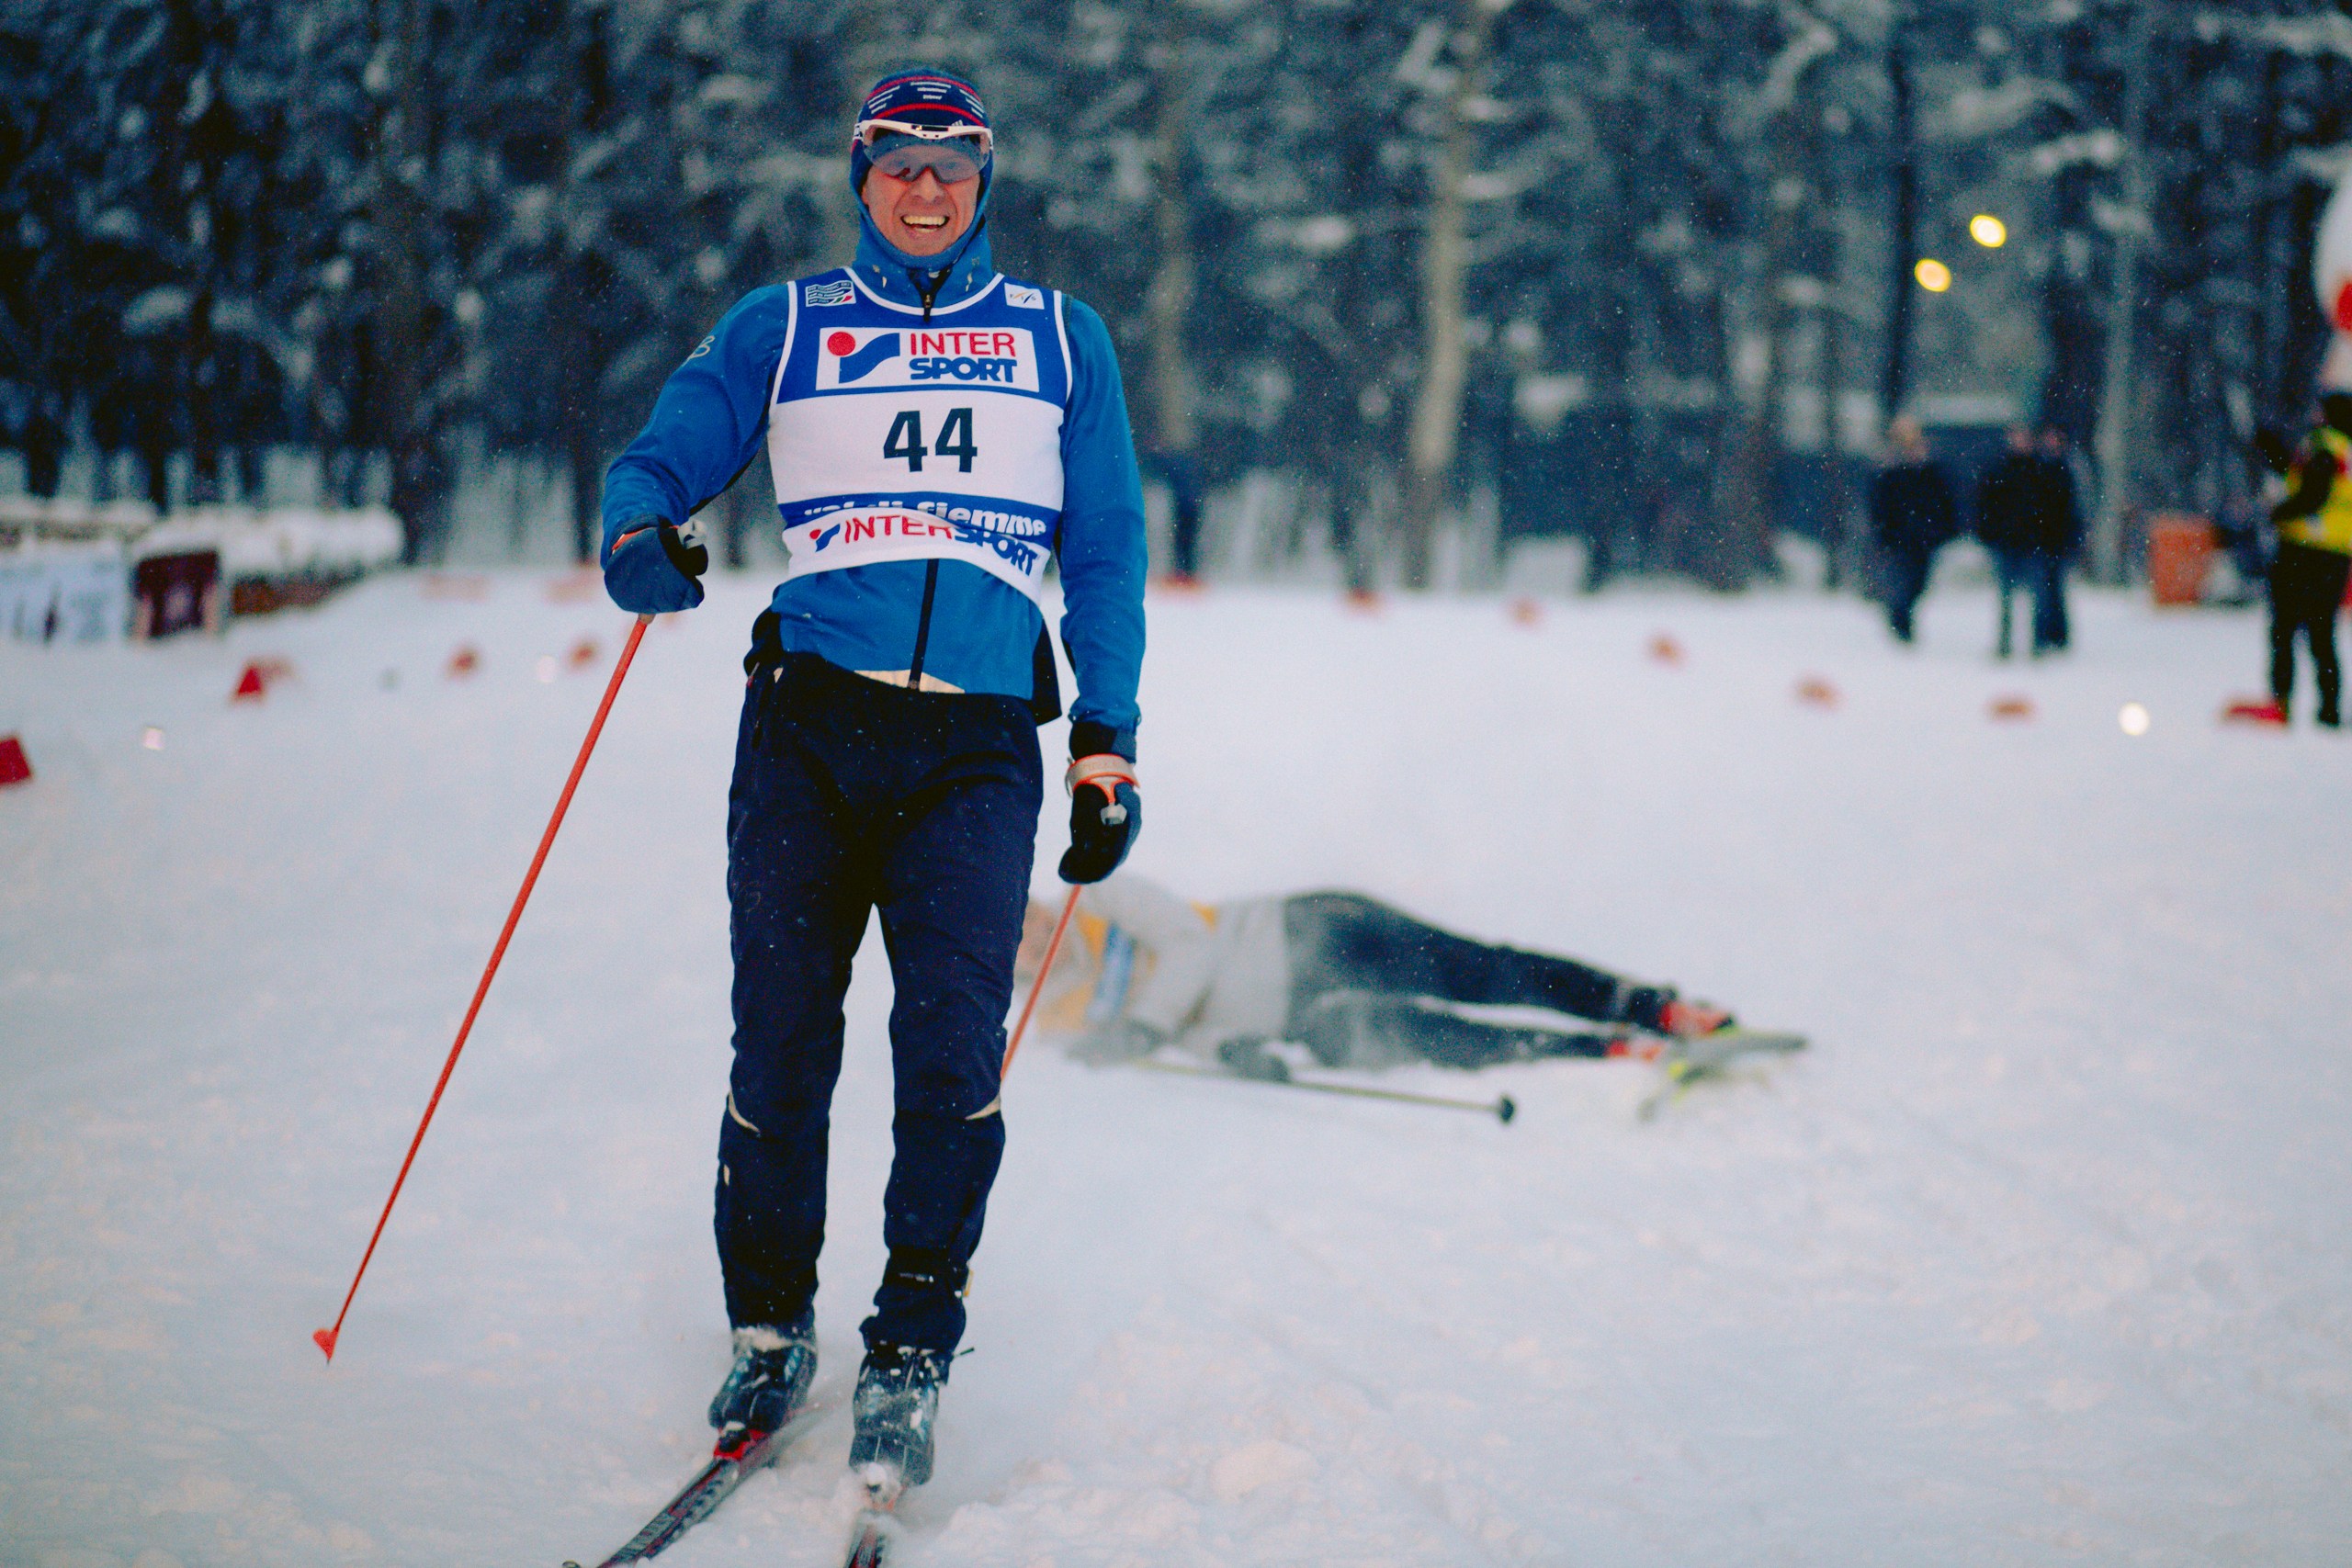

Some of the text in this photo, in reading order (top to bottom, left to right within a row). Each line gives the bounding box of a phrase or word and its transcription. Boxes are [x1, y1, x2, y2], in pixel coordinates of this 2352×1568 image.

[910, 333, 1016, 357] INTER
[909, 356, 1018, 383] SPORT
[883, 407, 978, 473] 44
